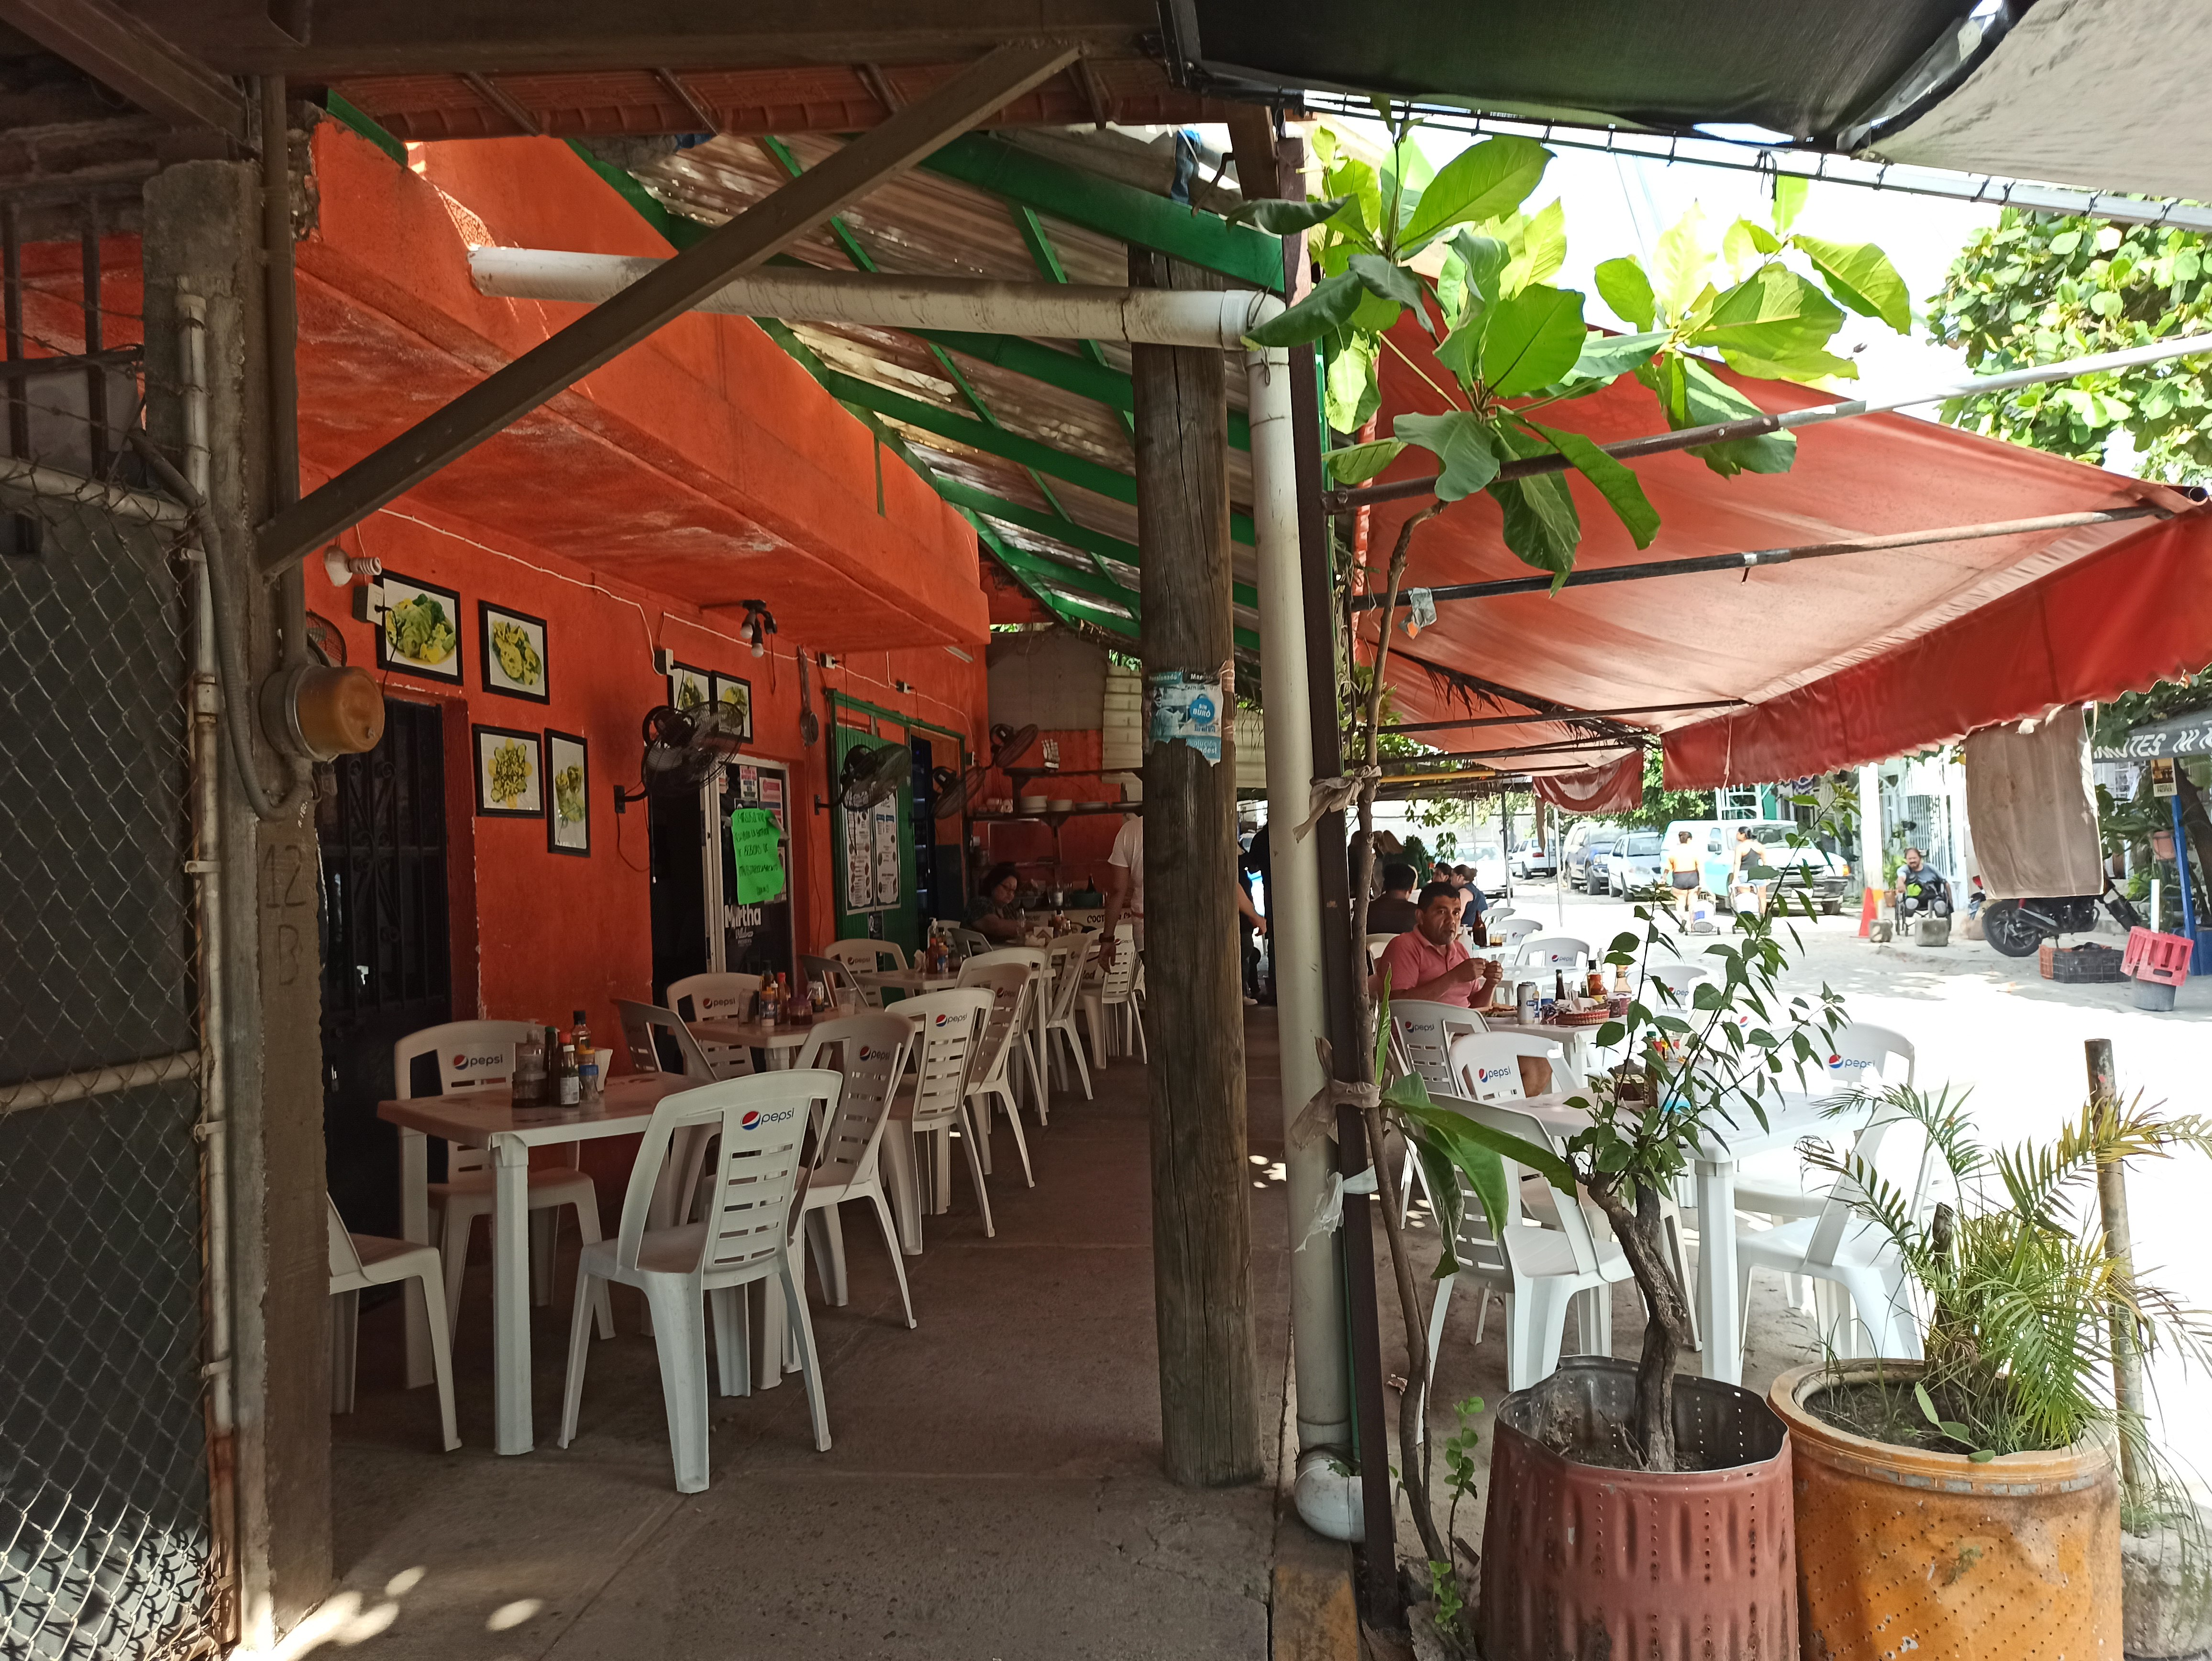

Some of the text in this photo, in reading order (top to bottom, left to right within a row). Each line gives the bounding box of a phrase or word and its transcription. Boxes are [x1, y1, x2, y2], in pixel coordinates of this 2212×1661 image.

[263, 844, 307, 908] 12
[277, 924, 299, 986] B
[713, 997, 736, 1008] pepsi
[947, 1013, 967, 1024] pepsi
[470, 1054, 503, 1067] pepsi
[870, 1050, 890, 1062] pepsi
[1488, 1066, 1511, 1080] pepsi
[761, 1107, 794, 1125] pepsi
